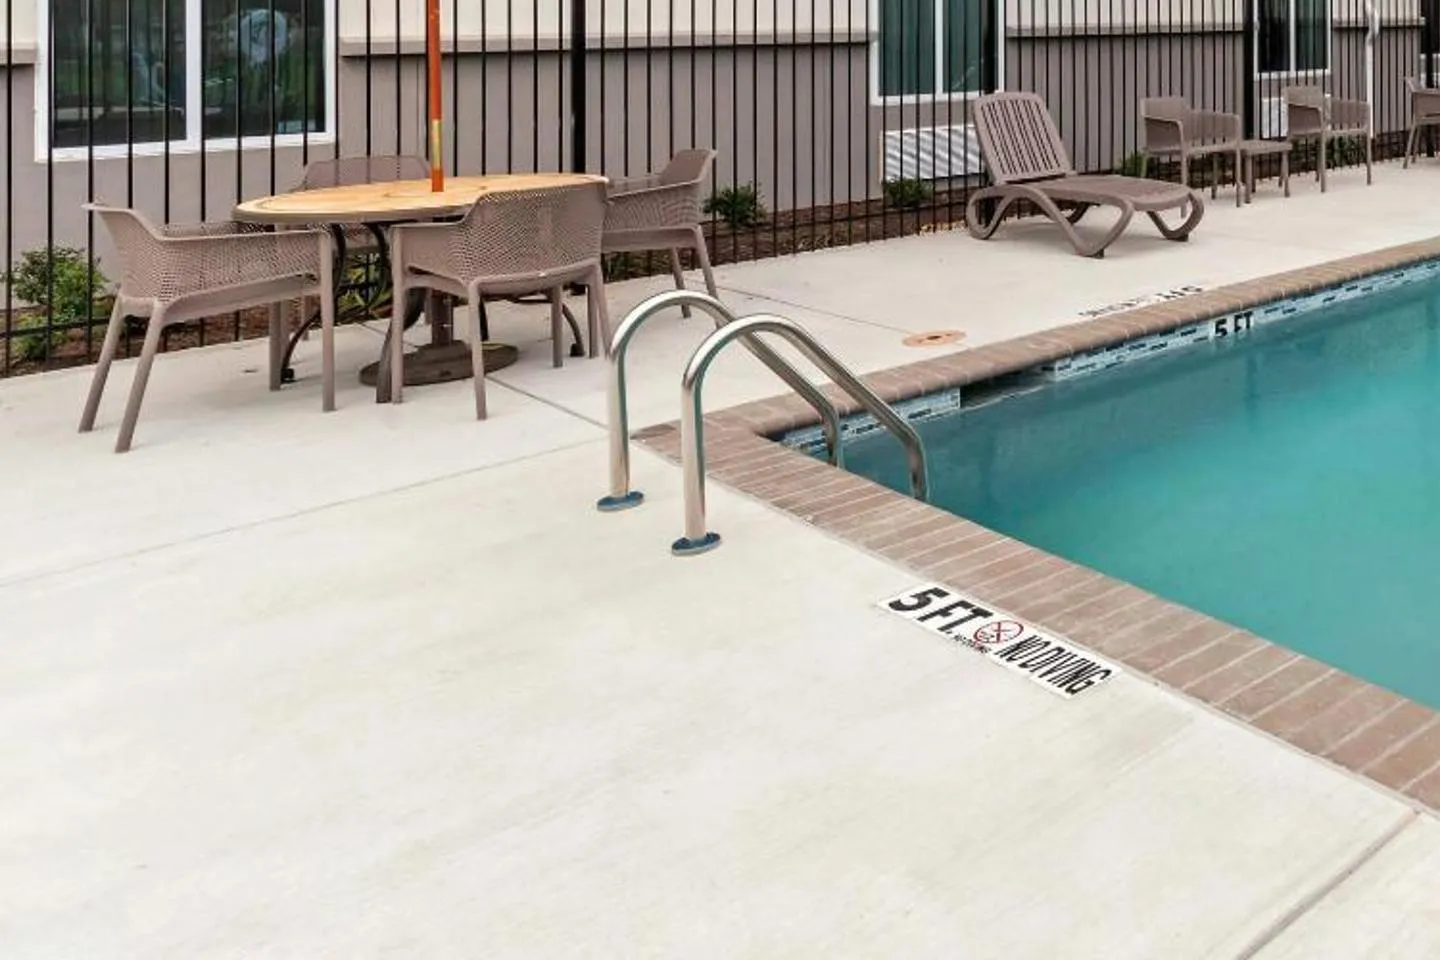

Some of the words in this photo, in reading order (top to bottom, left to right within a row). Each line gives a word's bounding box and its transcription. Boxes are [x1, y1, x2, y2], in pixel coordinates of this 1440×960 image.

[1215, 318, 1228, 337] 5
[1234, 311, 1252, 332] FT
[888, 587, 950, 612] 5
